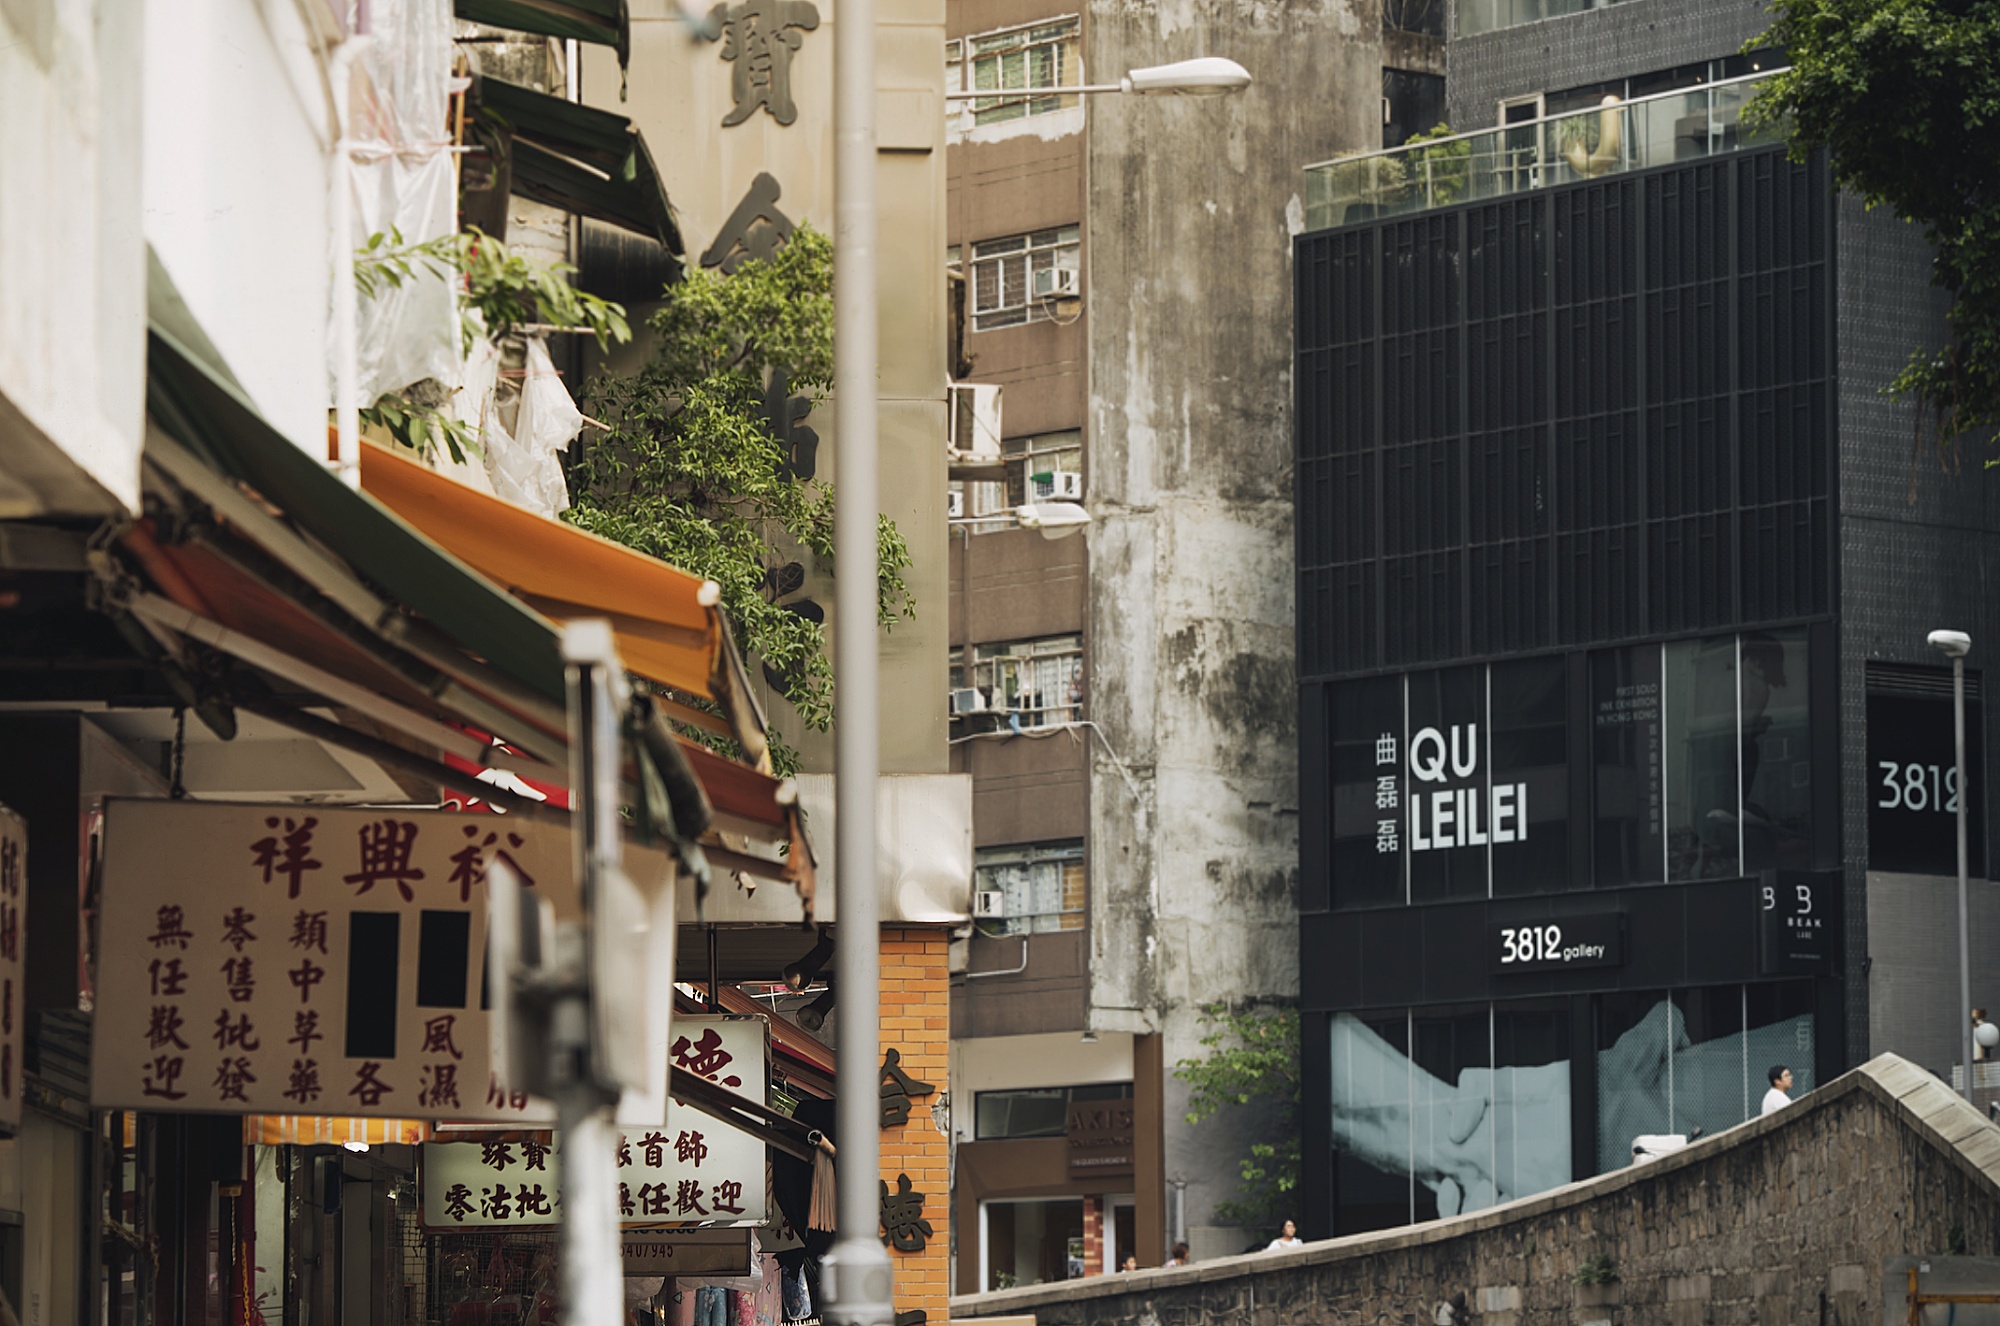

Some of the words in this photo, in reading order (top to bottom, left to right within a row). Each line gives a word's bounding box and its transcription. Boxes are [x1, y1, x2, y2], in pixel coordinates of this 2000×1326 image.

[1410, 723, 1477, 782] QU
[1375, 732, 1398, 853] 曲磊磊
[1411, 782, 1527, 851] LEILEI
[1501, 924, 1562, 963] 3812
[1563, 944, 1605, 962] gallery
[1787, 916, 1822, 928] BEAK
[142, 904, 194, 1100] 無任歡迎
[212, 906, 260, 1102] 零售批發
[348, 1061, 395, 1107] 各
[1070, 1110, 1133, 1131] AXIS
